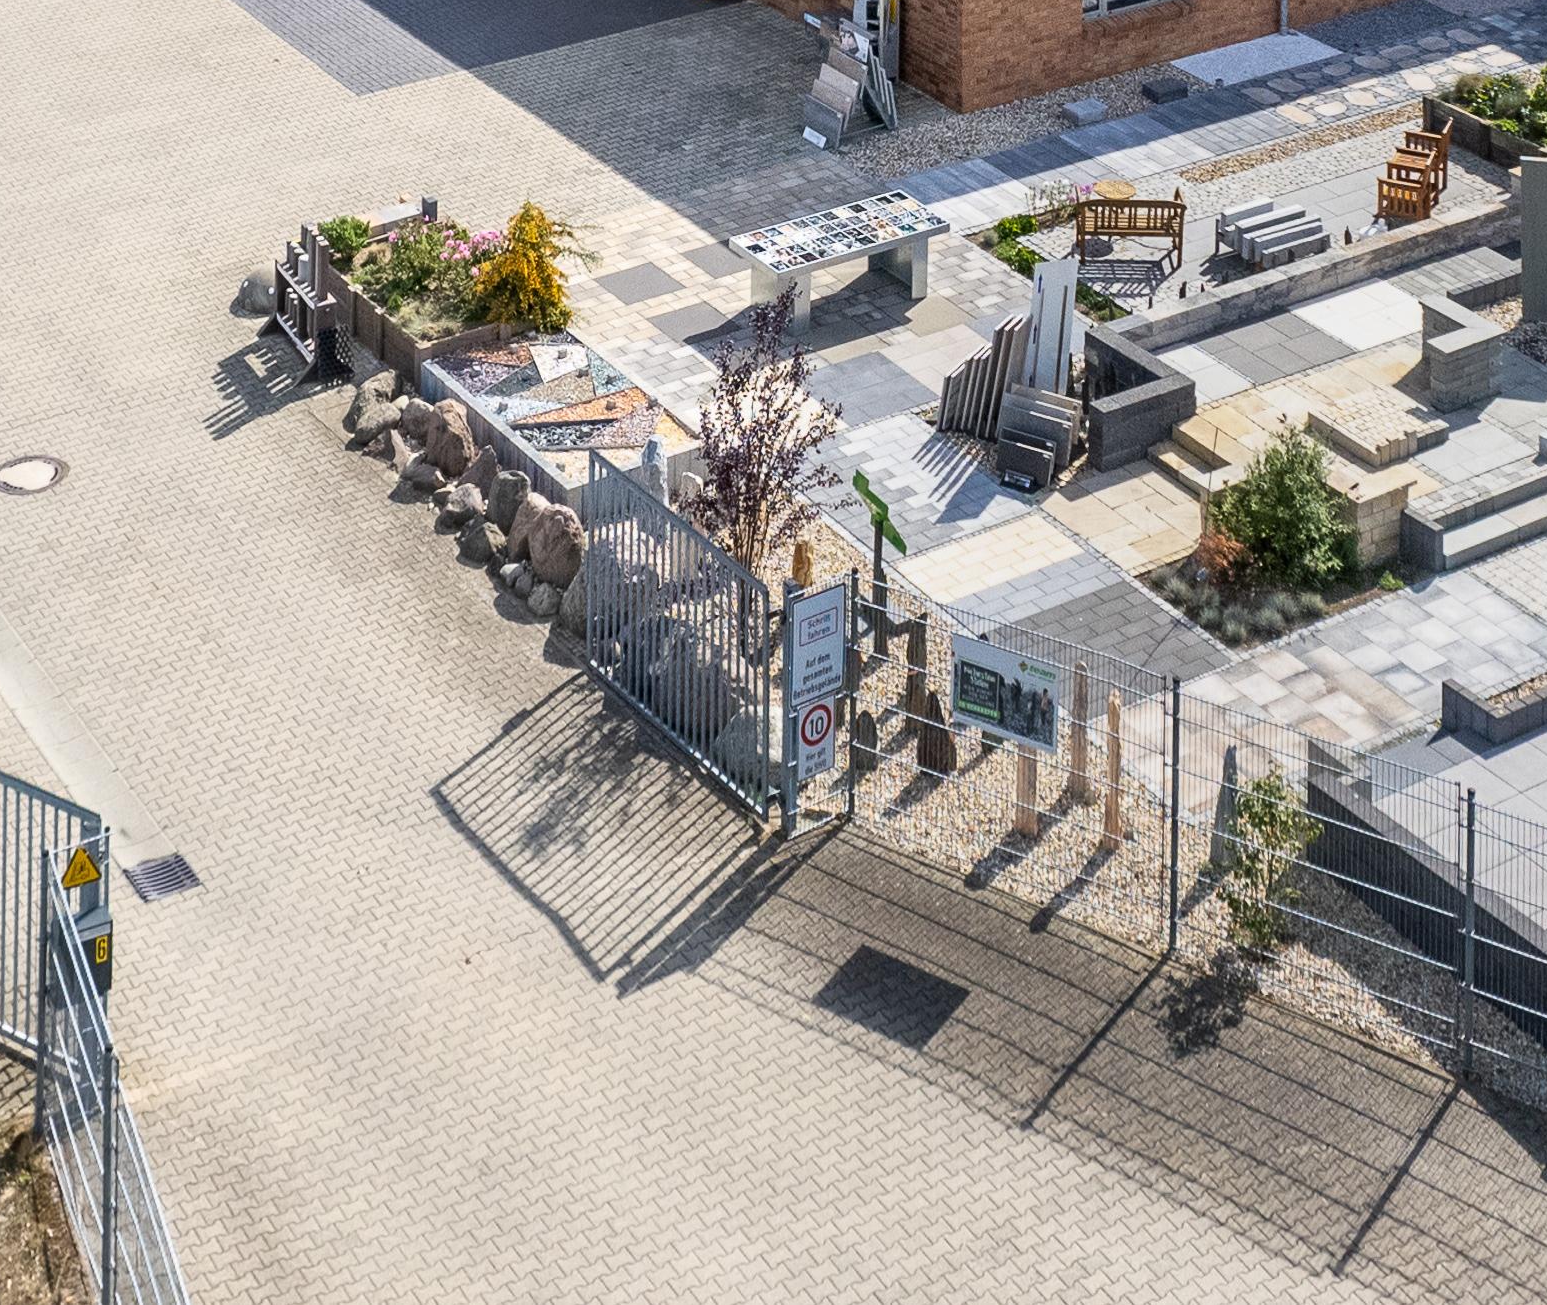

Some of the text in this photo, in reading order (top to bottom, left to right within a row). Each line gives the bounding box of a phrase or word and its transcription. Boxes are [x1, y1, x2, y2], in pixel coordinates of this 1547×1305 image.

[807, 614, 831, 630] Schritt
[807, 626, 831, 640] fahren
[805, 654, 831, 670] Auf dem
[802, 665, 833, 686] gesamten
[809, 716, 824, 738] 10
